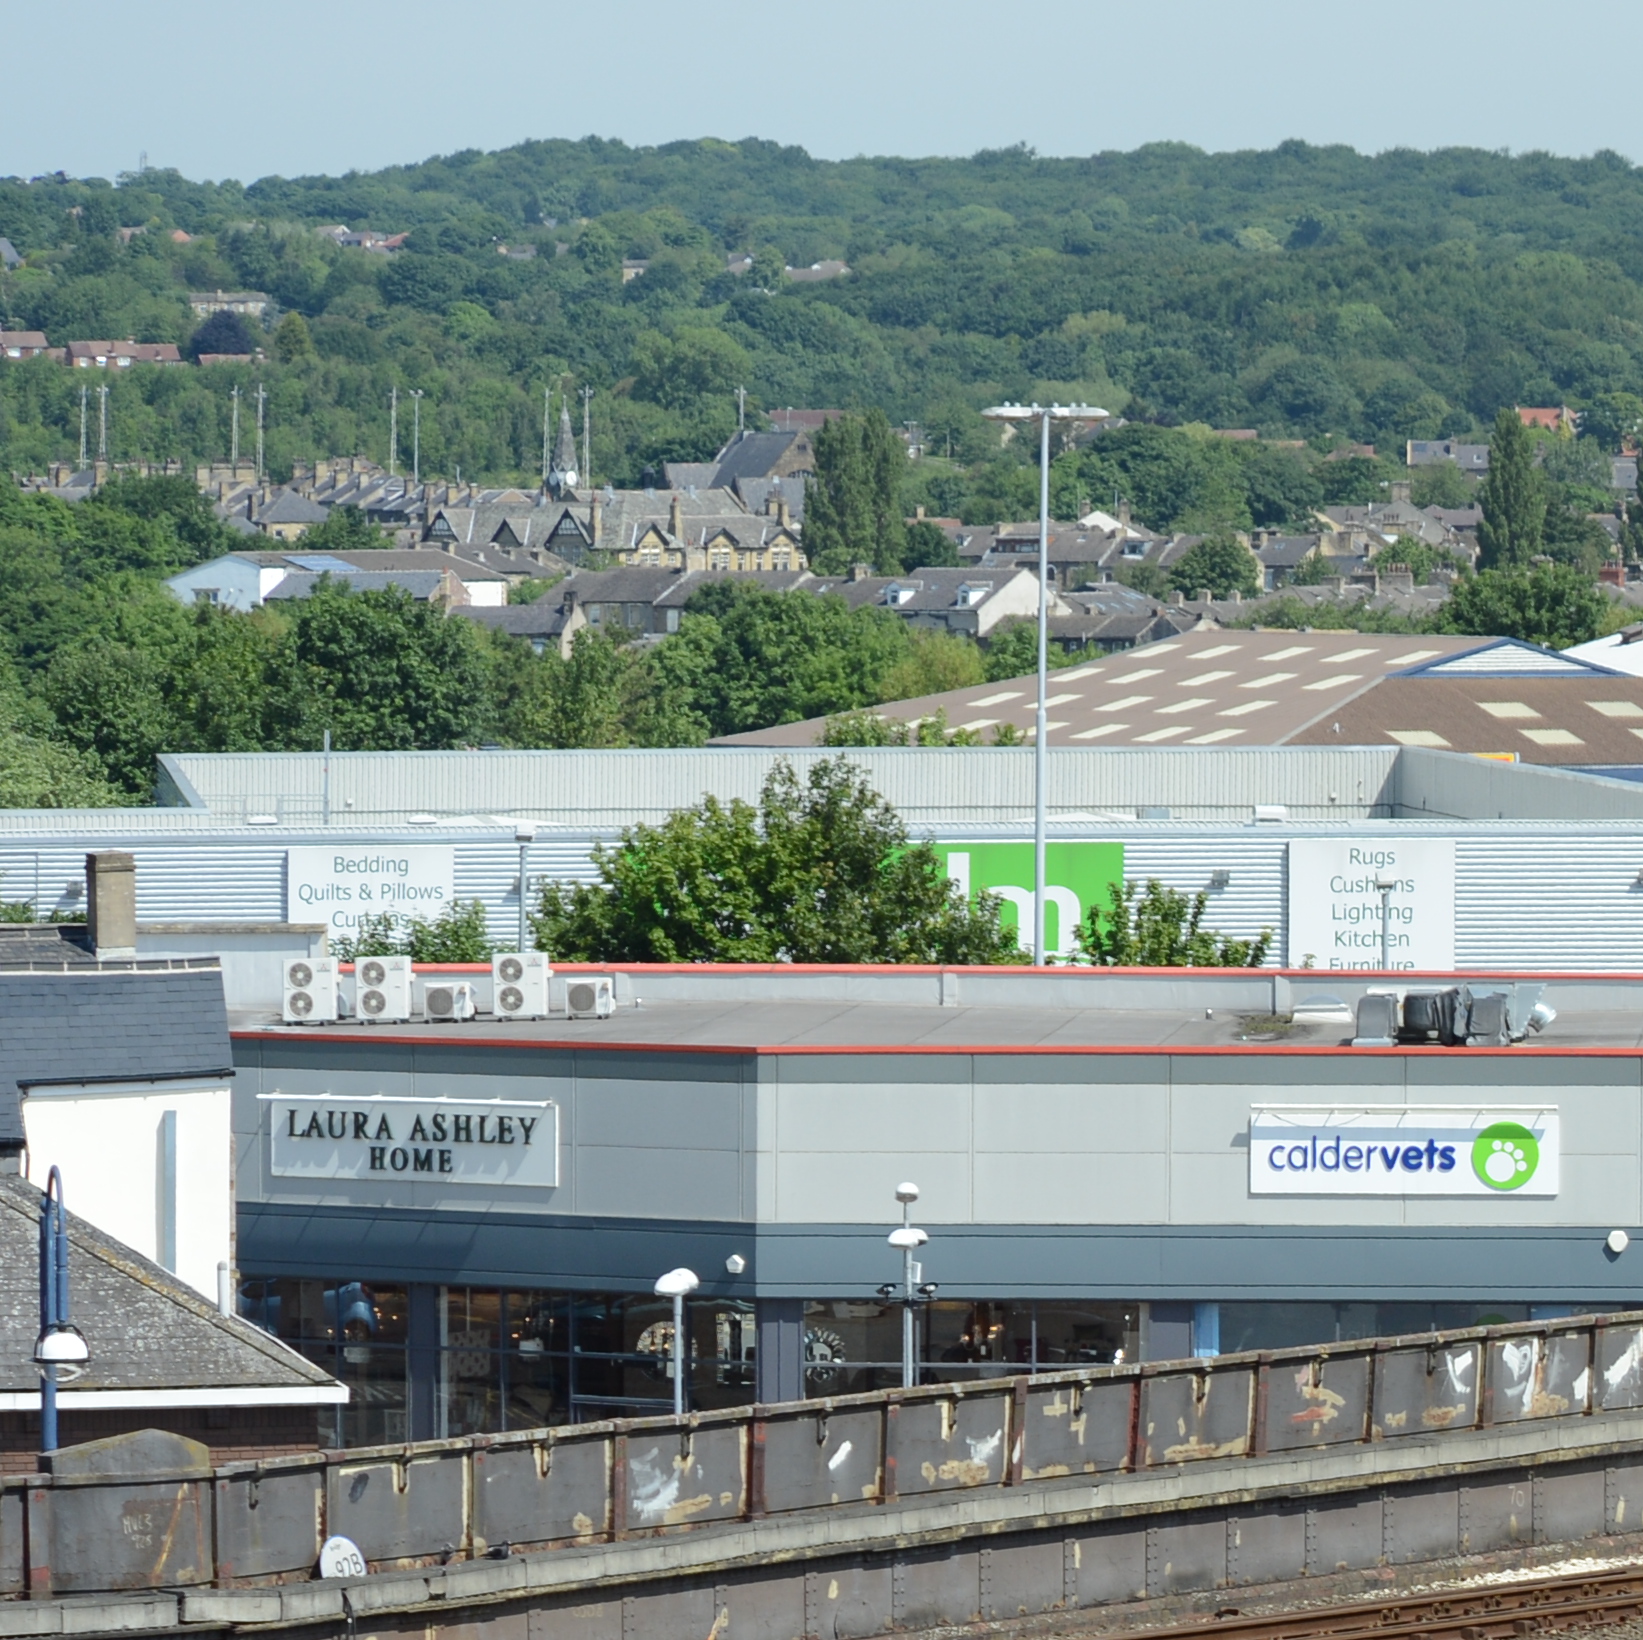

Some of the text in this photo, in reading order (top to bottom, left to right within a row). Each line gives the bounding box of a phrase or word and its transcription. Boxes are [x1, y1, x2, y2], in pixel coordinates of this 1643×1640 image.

[333, 855, 409, 877] Bedding
[1349, 848, 1396, 869] Rugs
[298, 882, 444, 905] Quilts & Pillows
[1329, 875, 1415, 893] Cushns
[1331, 903, 1413, 925] Lightng
[287, 1109, 538, 1145] LAURA ASHLEY
[369, 1146, 454, 1173] HOME
[1268, 1134, 1456, 1171] caldervets
